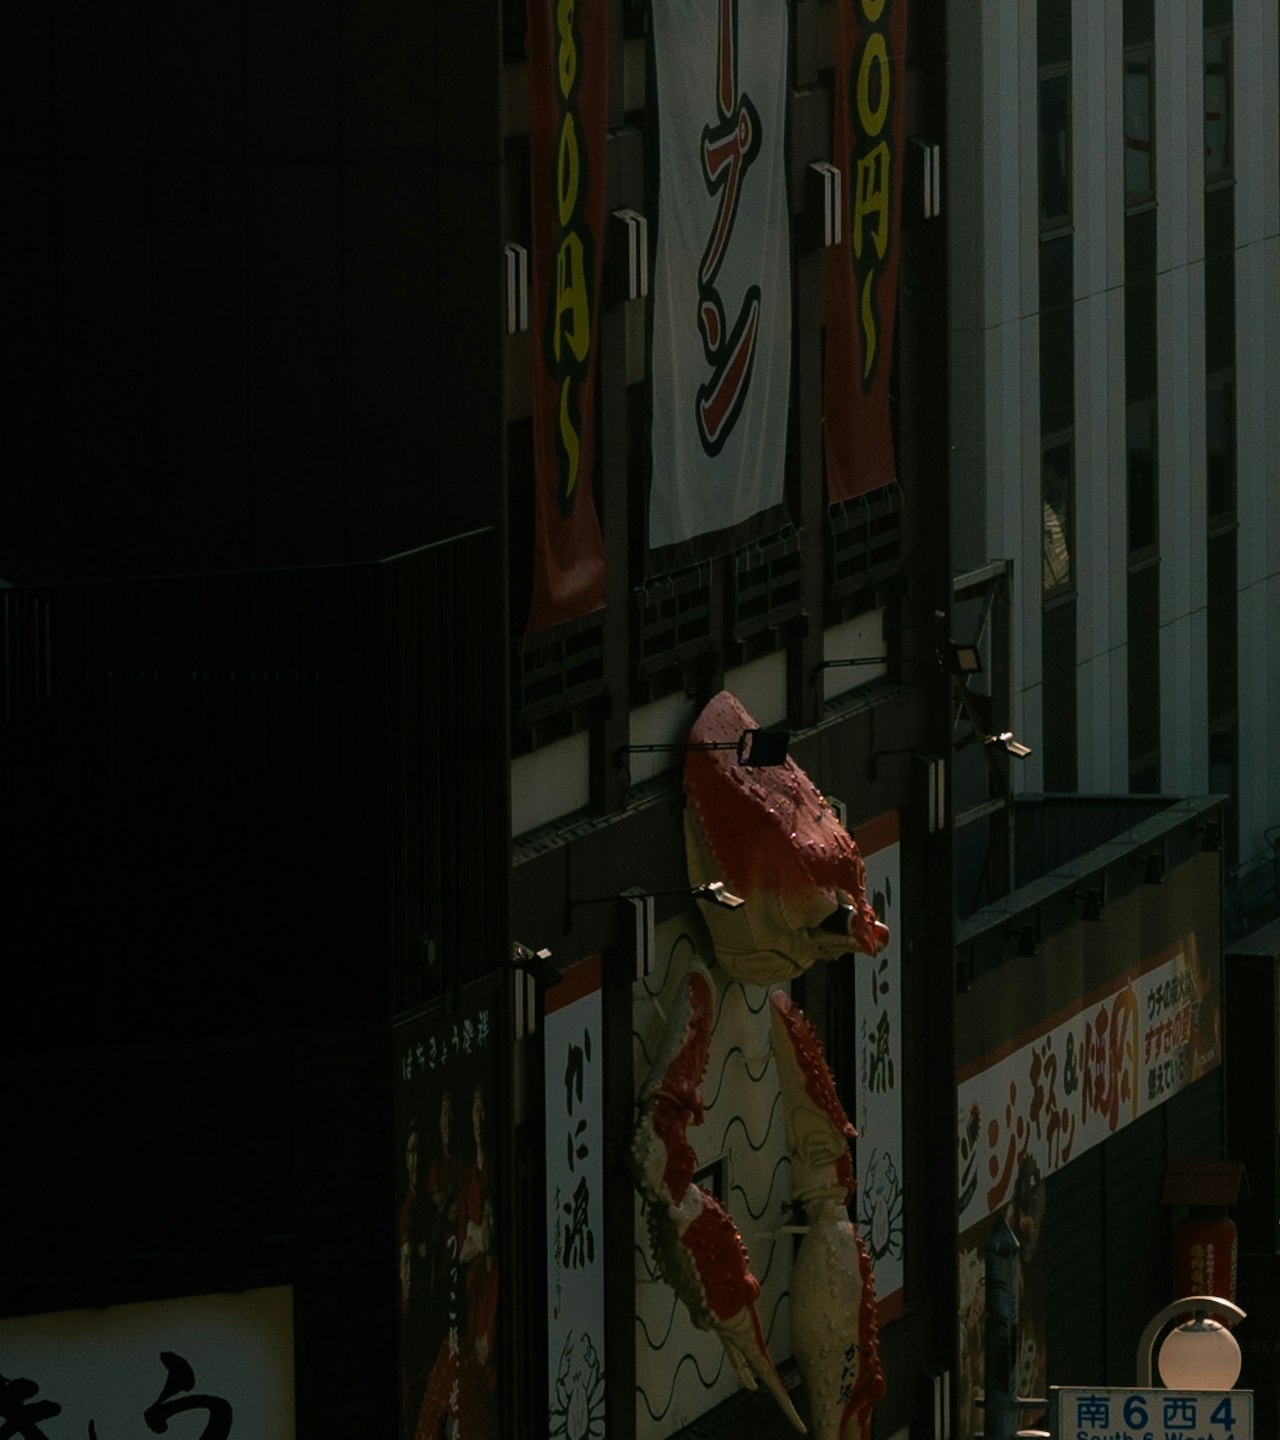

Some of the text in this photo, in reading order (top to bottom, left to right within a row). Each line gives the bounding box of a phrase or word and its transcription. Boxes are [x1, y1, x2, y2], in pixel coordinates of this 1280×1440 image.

[563, 1028, 595, 1270] かに源
[1076, 1395, 1236, 1431] 南6西4
